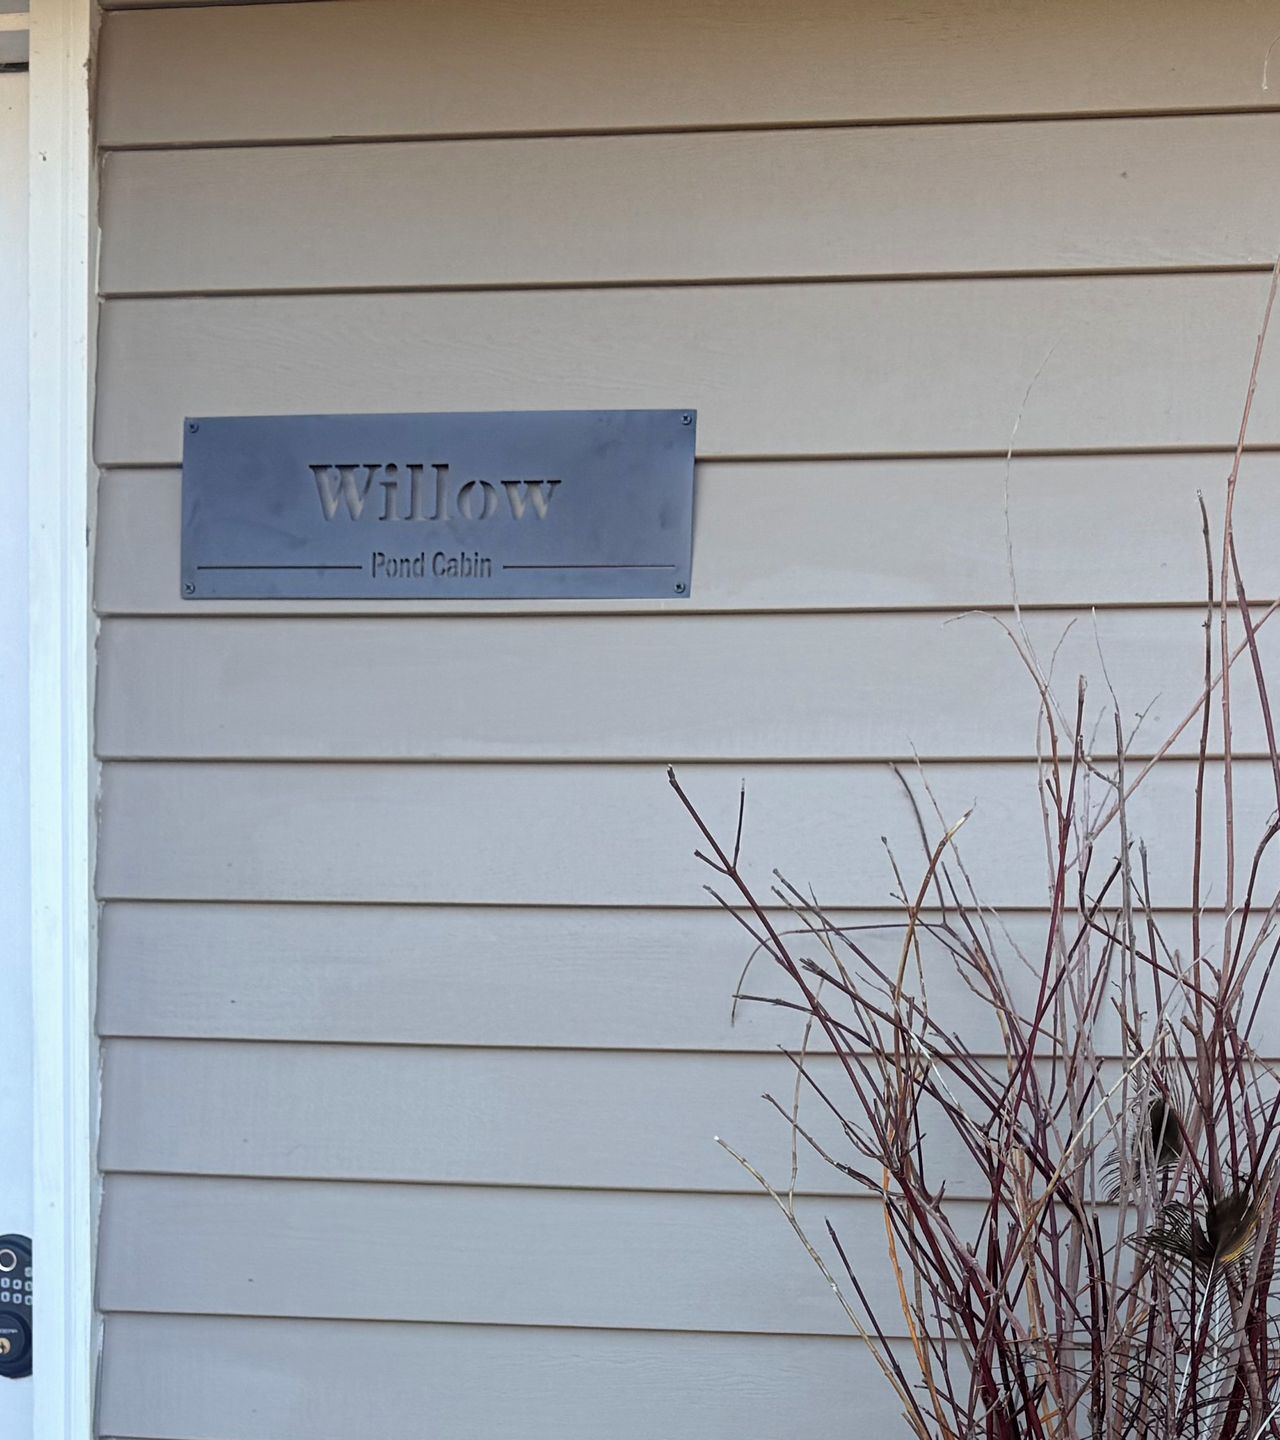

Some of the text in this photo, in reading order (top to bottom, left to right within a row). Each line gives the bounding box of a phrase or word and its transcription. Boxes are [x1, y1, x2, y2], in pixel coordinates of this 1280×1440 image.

[308, 462, 562, 522] Willow
[371, 551, 493, 579] Pond Cabin
